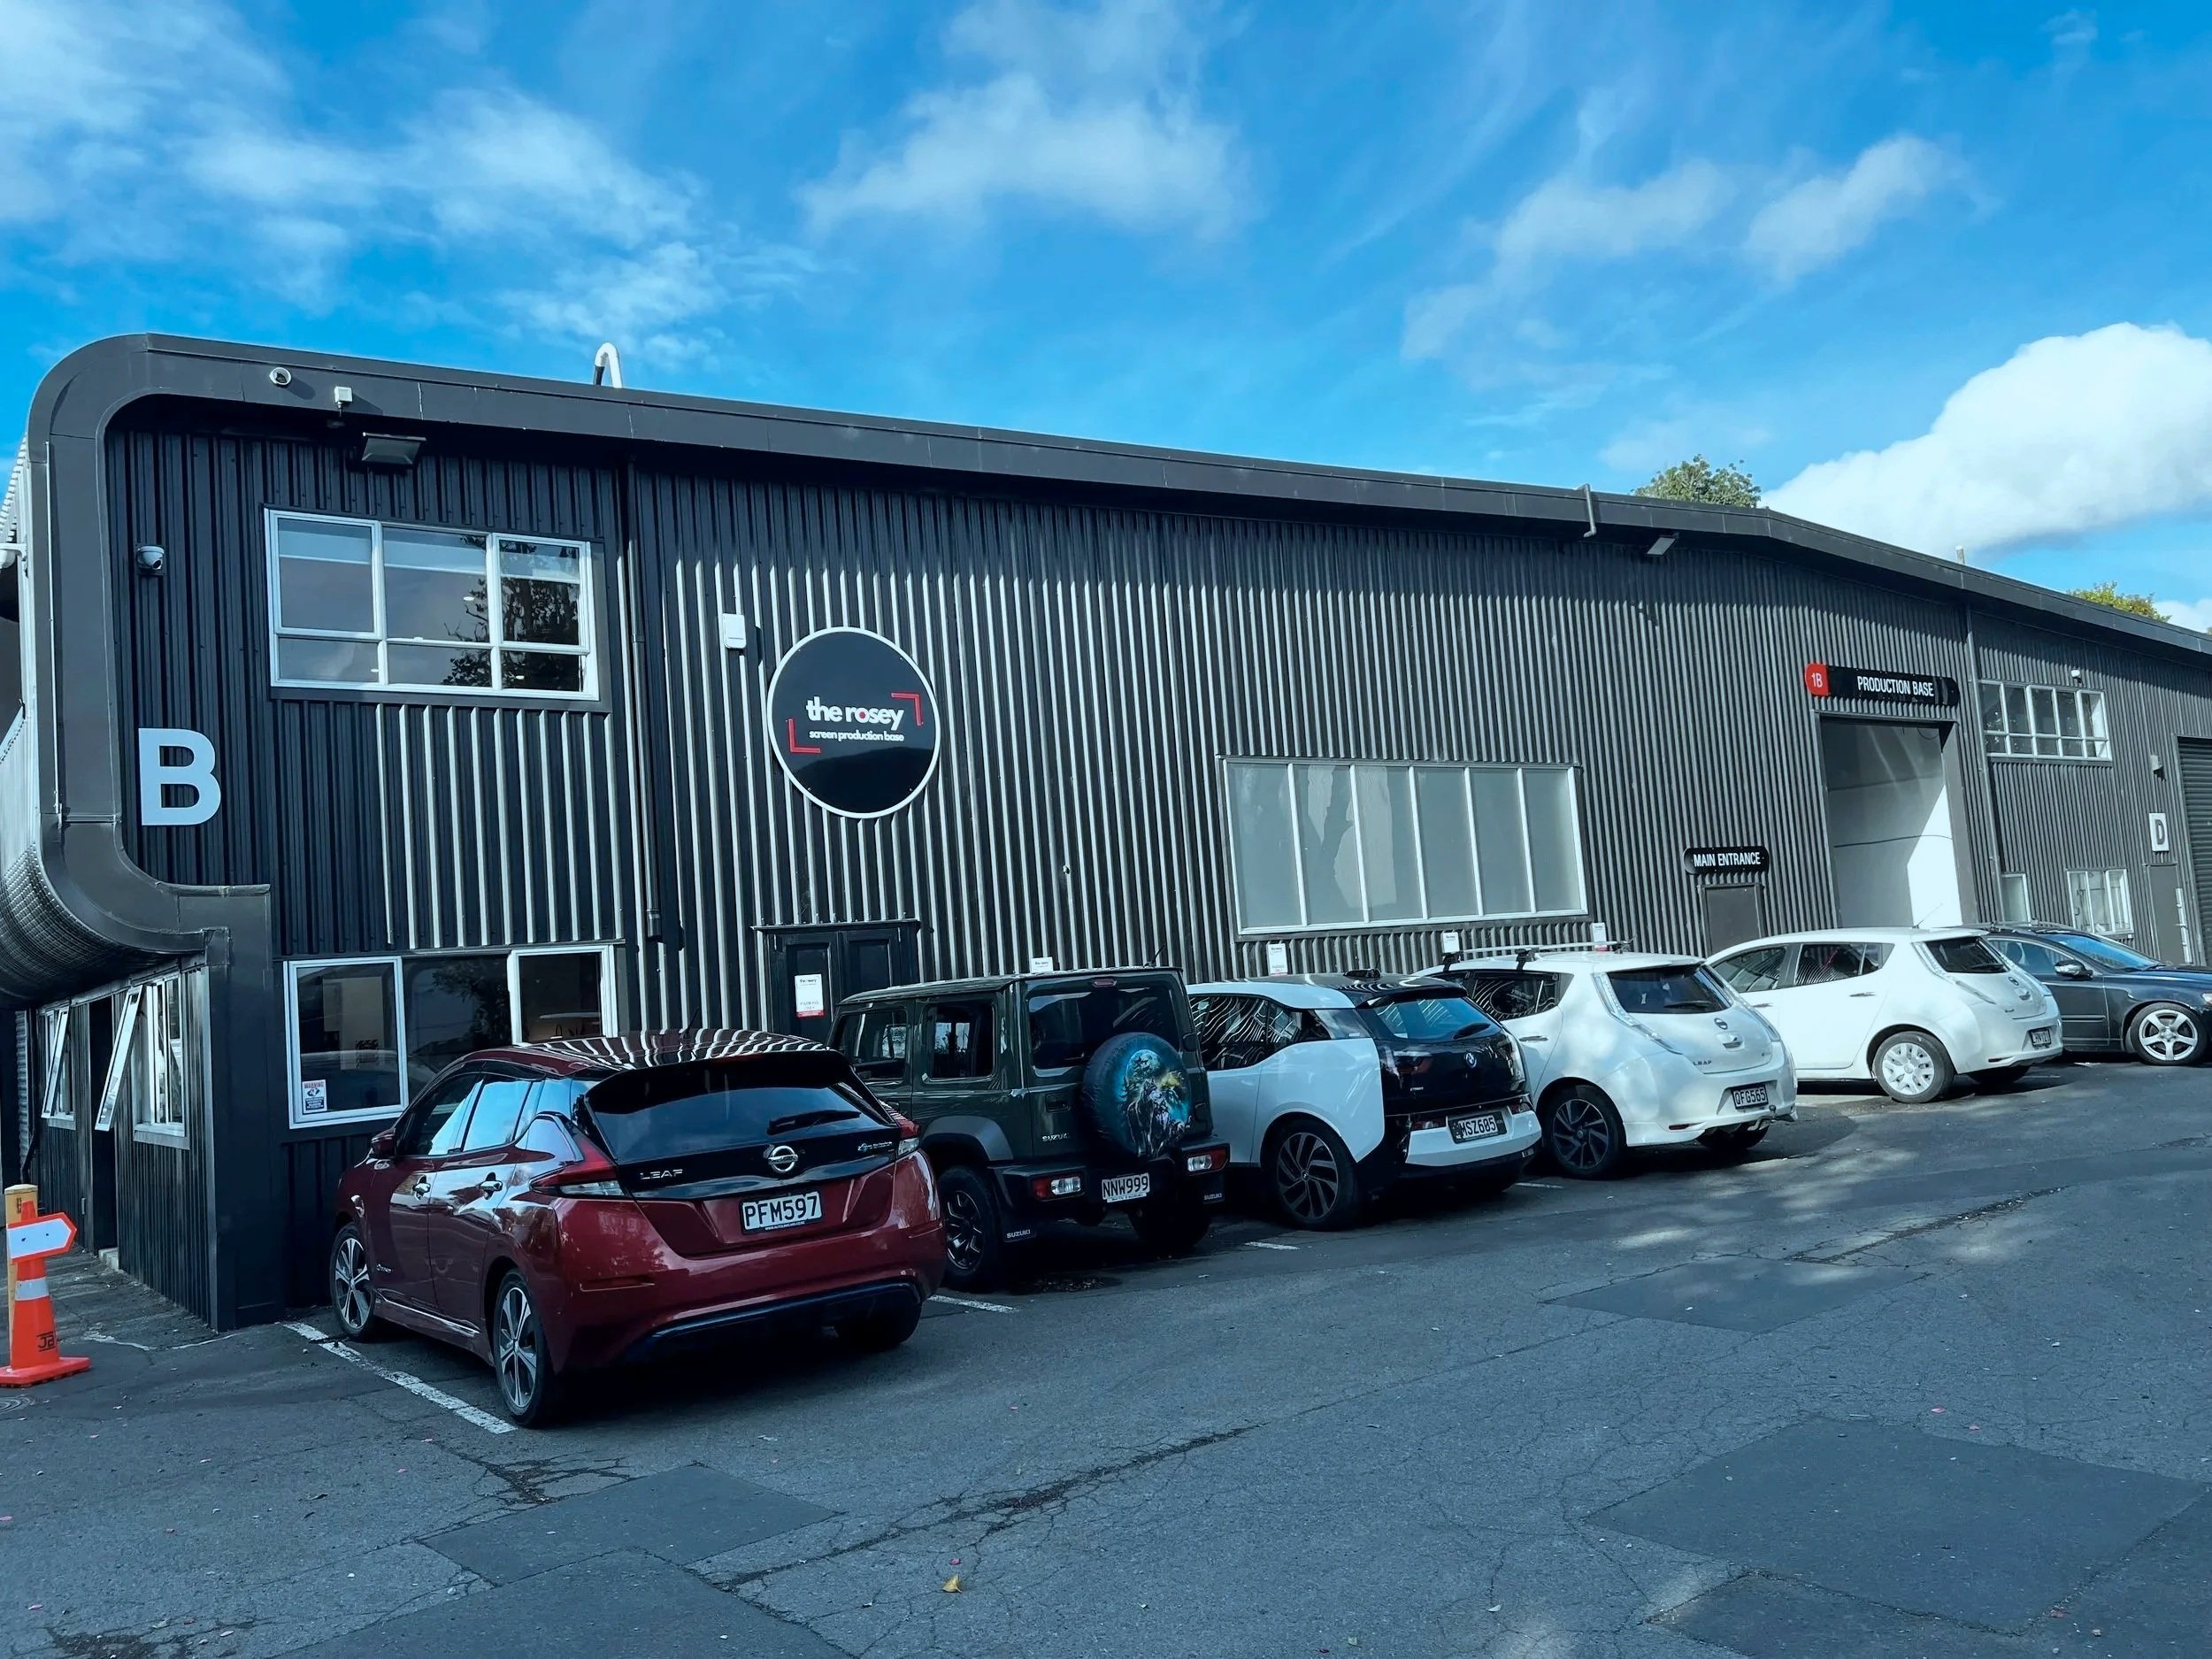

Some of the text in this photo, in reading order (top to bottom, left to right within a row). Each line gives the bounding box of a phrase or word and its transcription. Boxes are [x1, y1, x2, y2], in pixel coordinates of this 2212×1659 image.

[1811, 672, 1823, 687] 1B
[1856, 675, 1934, 696] PRODUCTION BASE
[805, 696, 905, 731] the rosey
[809, 730, 905, 741] screen production base
[138, 727, 221, 826] B
[2154, 818, 2166, 845] D
[1693, 851, 1762, 867] MAIN ENTRANCE
[1734, 1088, 1766, 1105] QFG565
[639, 1169, 683, 1179] LEAF
[1102, 1175, 1148, 1198] NNW999
[744, 1195, 818, 1227] PFM597
[1006, 1229, 1031, 1239] SUZUKI
